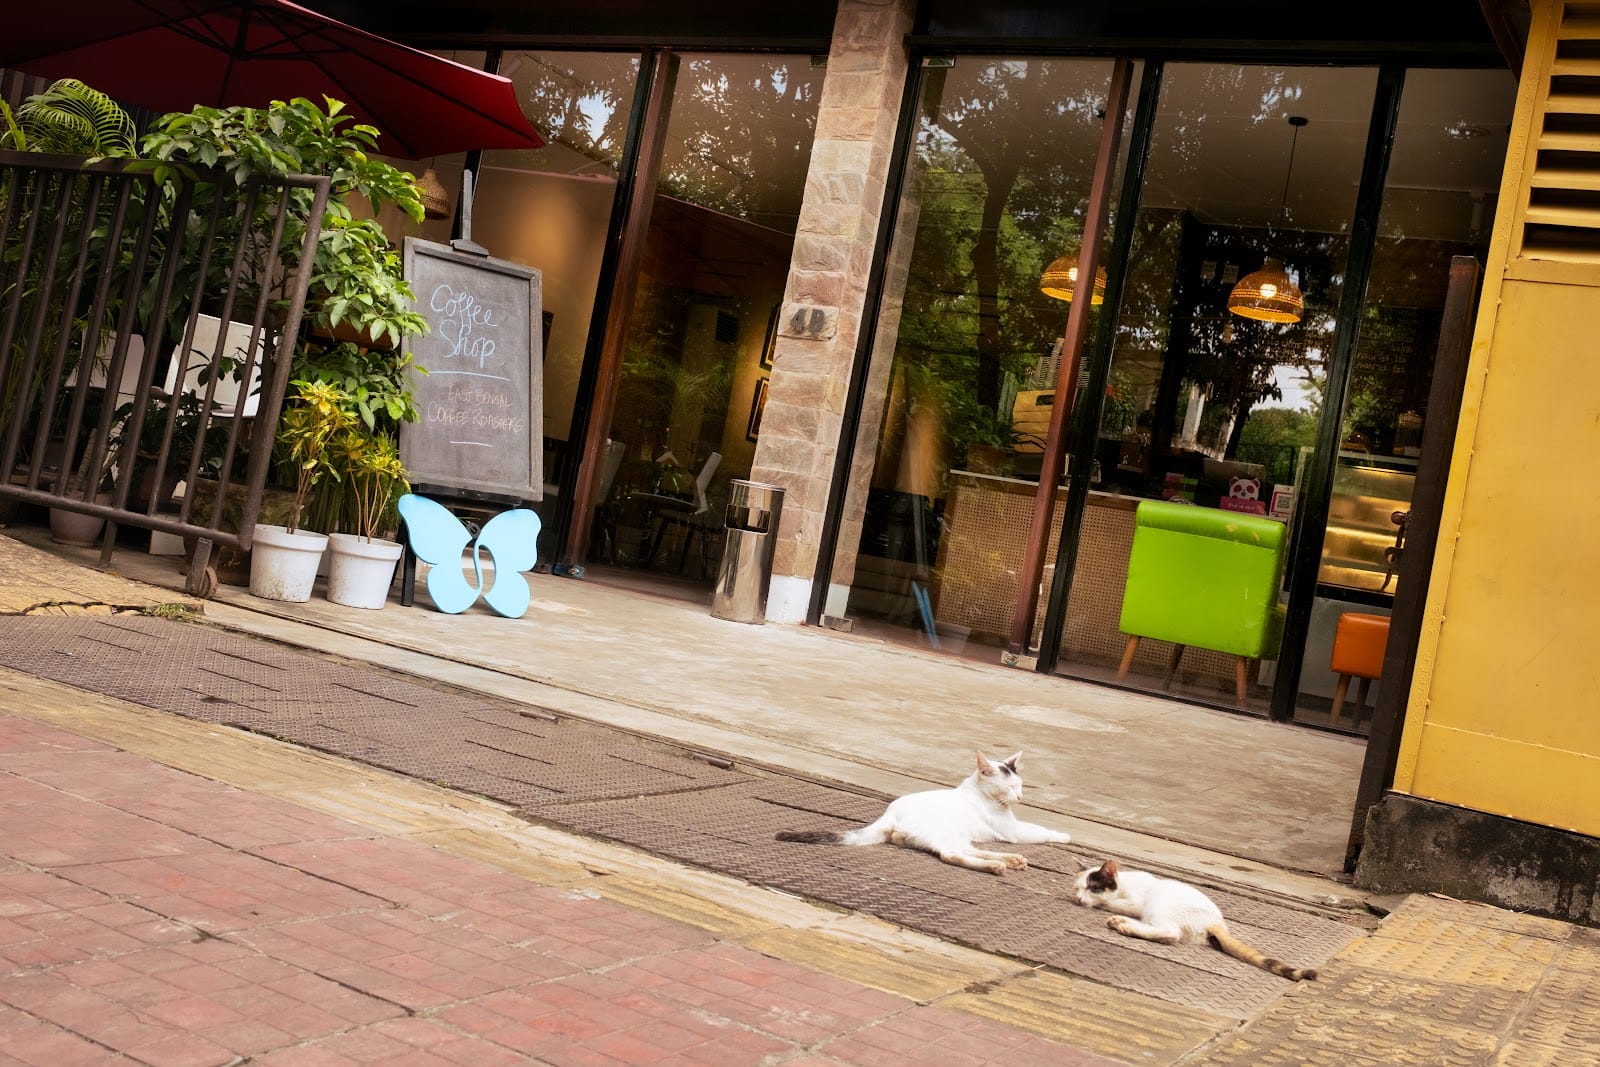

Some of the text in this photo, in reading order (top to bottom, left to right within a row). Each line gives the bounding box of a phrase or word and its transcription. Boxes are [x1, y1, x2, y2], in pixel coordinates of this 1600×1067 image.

[430, 284, 498, 330] Coffee
[439, 319, 496, 368] Shop
[447, 384, 473, 403] EAST
[427, 400, 523, 433] COFFEE ROASTERS
